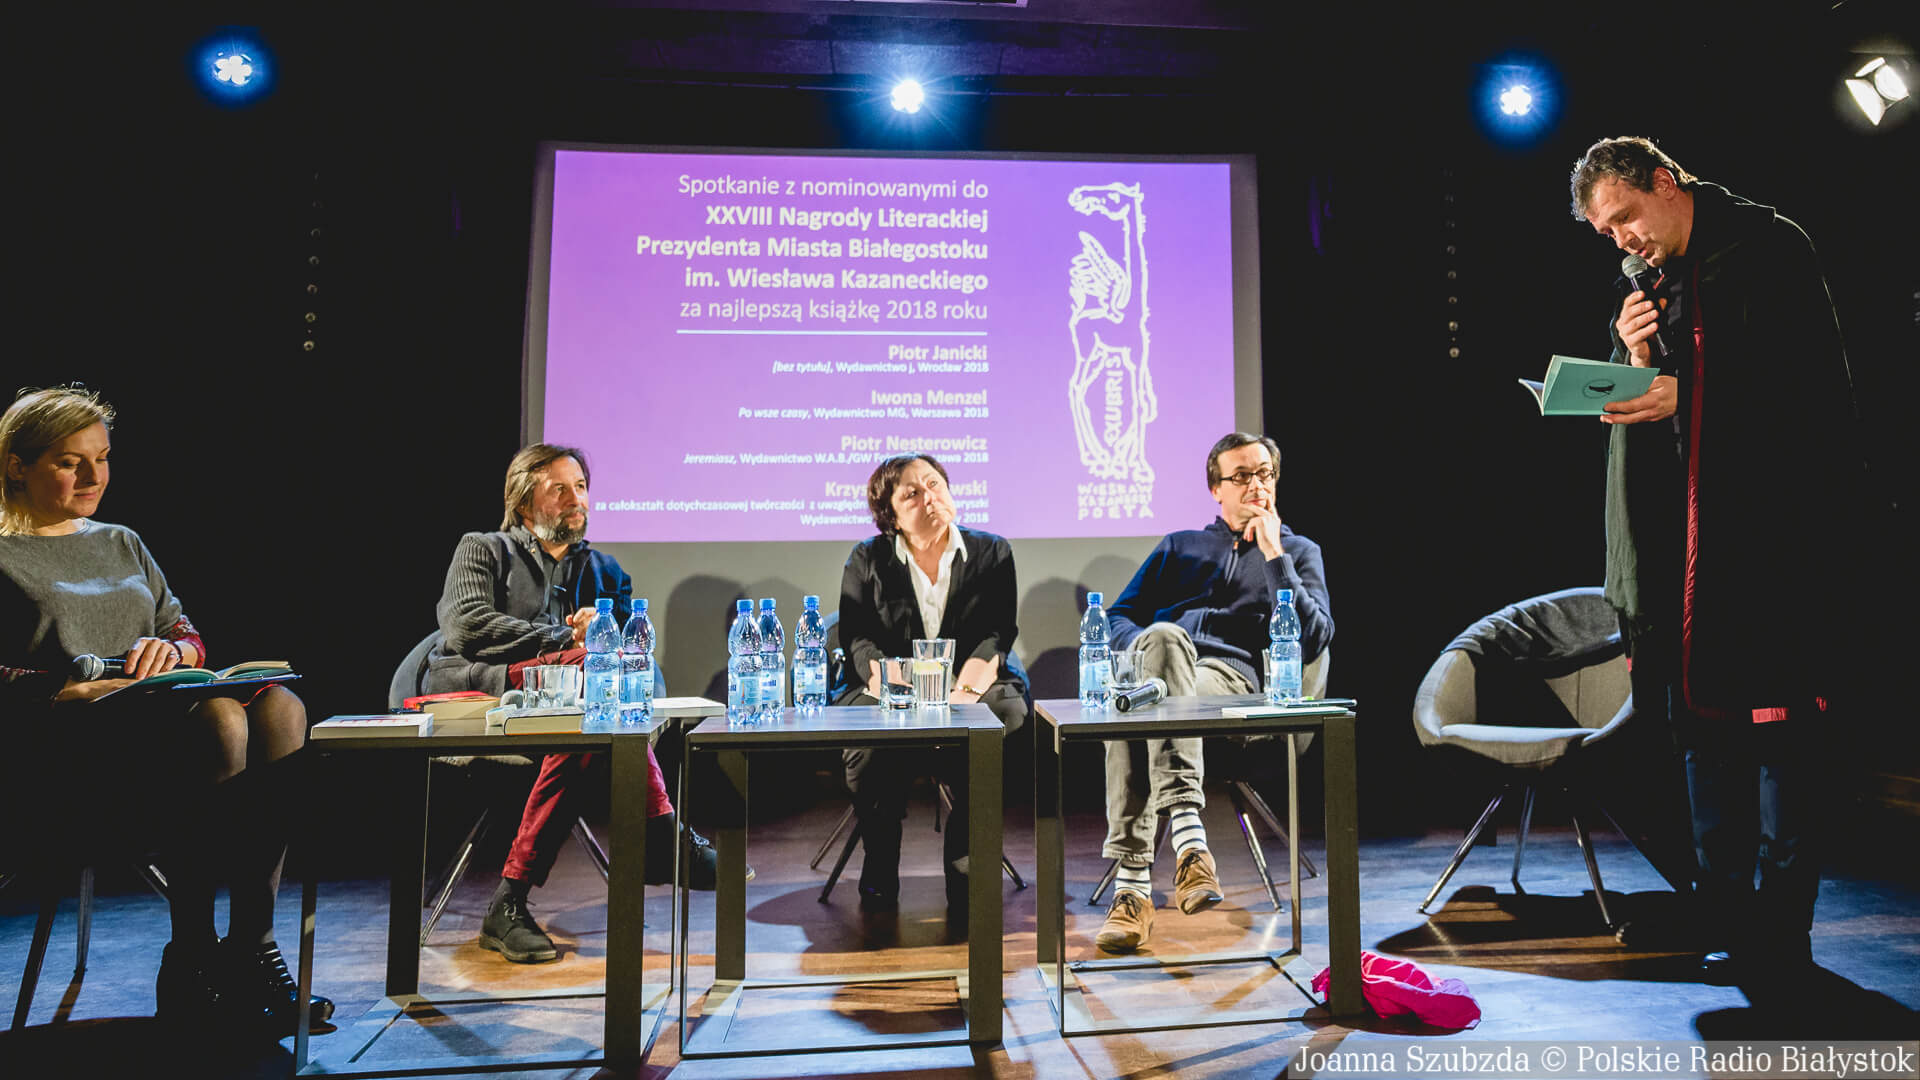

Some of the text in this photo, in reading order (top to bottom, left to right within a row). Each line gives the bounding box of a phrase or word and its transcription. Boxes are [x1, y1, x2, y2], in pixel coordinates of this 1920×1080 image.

[678, 174, 780, 198] Spotkanie
[801, 177, 957, 201] nominowanymi
[962, 179, 989, 199] do
[705, 205, 988, 233] XXVIII Nagrody Literackiej
[636, 235, 988, 263] Prezydenta Miasta Białegostoku
[685, 266, 989, 294] im. Wiesława Kazaneckiego
[679, 298, 988, 324] za najlepszą książkę 2018 roku
[888, 344, 987, 361] Piotr Janicki
[835, 361, 908, 374] Wydawnictwo
[917, 361, 963, 373] Wrocław
[963, 361, 990, 373] 2018
[871, 389, 987, 405] Iwona Menzel
[738, 406, 989, 420] Po wsze czasy, Wydawnictwo MG, Warszawa 2018
[841, 434, 988, 453] Piotr Nesterowicz
[683, 453, 737, 465] Jeremiasz,
[739, 453, 813, 466] Wydawnictwo
[963, 452, 989, 463] 2018
[824, 479, 988, 500] Krzys wski
[595, 502, 607, 511] za
[665, 499, 749, 513] dotychczasowej
[750, 499, 805, 511] twórczości
[817, 500, 868, 513] uwzględn
[1077, 504, 1154, 521] POETA
[799, 514, 873, 527] Wydawnictwo
[963, 511, 989, 524] 2018
